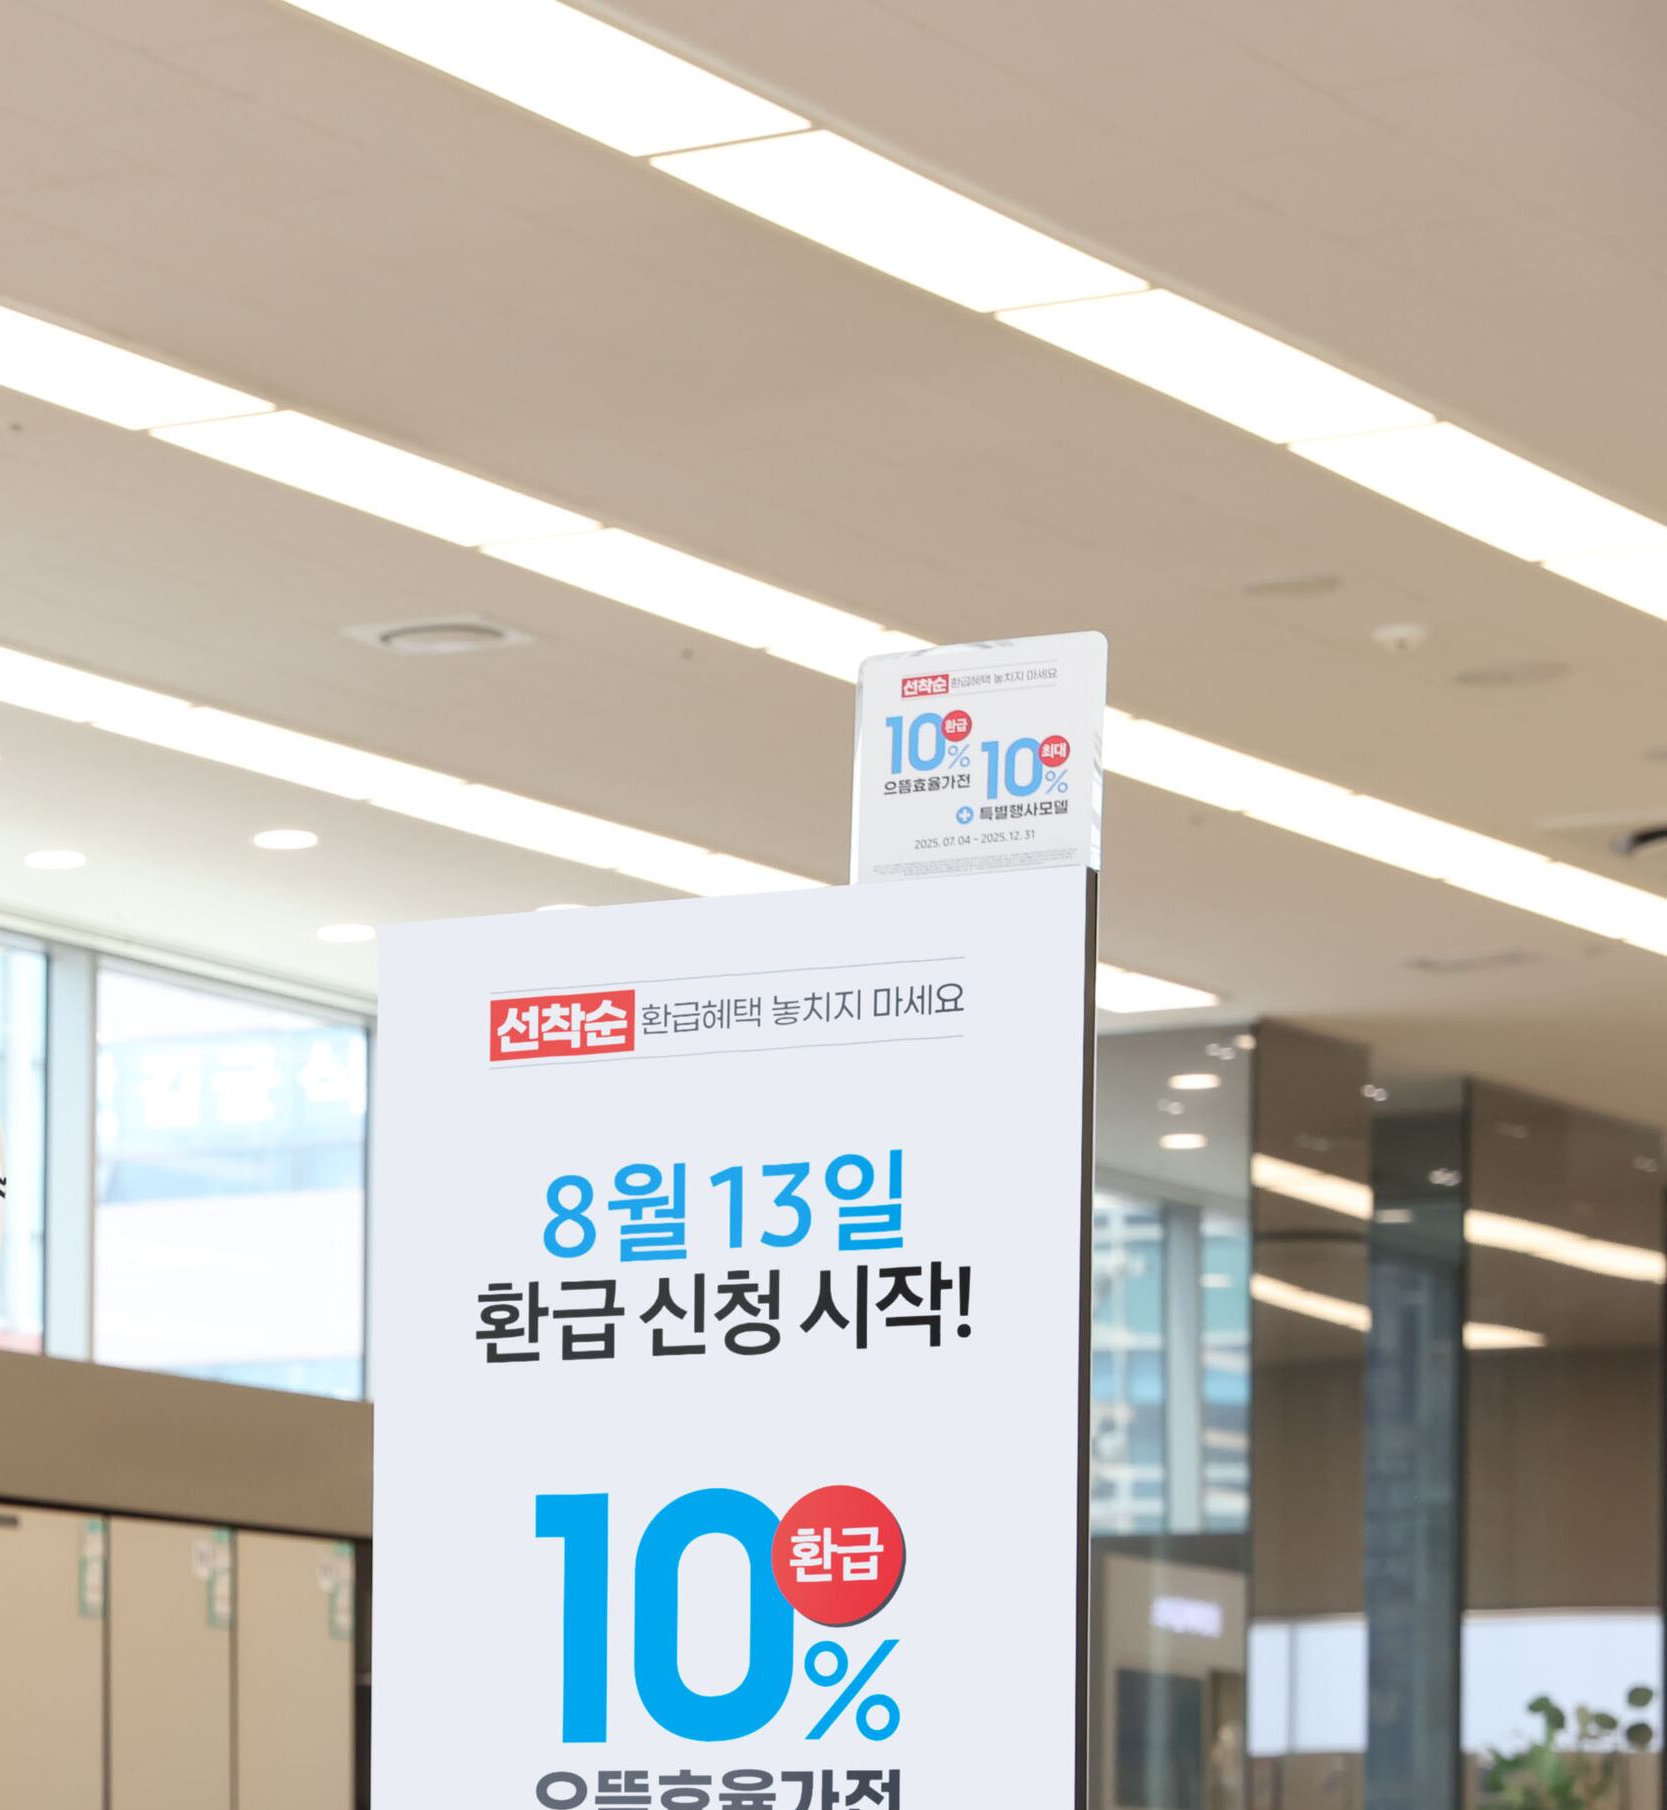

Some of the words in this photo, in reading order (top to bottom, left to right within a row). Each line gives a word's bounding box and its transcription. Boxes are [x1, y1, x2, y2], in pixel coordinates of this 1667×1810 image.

[903, 677, 947, 695] 선착순
[951, 674, 991, 689] 환급혜택
[993, 671, 1024, 684] 놓치지
[1026, 667, 1058, 681] 마세요
[944, 719, 968, 734] 환급
[1041, 742, 1067, 758] 최대
[884, 773, 971, 795] 으뜸효율가전
[979, 800, 1068, 821] 특별행사모델
[496, 1000, 630, 1052] 선착순
[641, 1000, 761, 1035] 환급혜택
[771, 989, 862, 1026] 놓치지
[873, 982, 965, 1017] 마세요
[543, 1162, 687, 1263] 8월
[710, 1149, 904, 1251] 13일
[475, 1279, 626, 1364] 환급
[638, 1268, 782, 1357] 신청
[799, 1260, 973, 1350] 시작!
[789, 1527, 884, 1583] 환급
[534, 1487, 901, 1743] 10%
